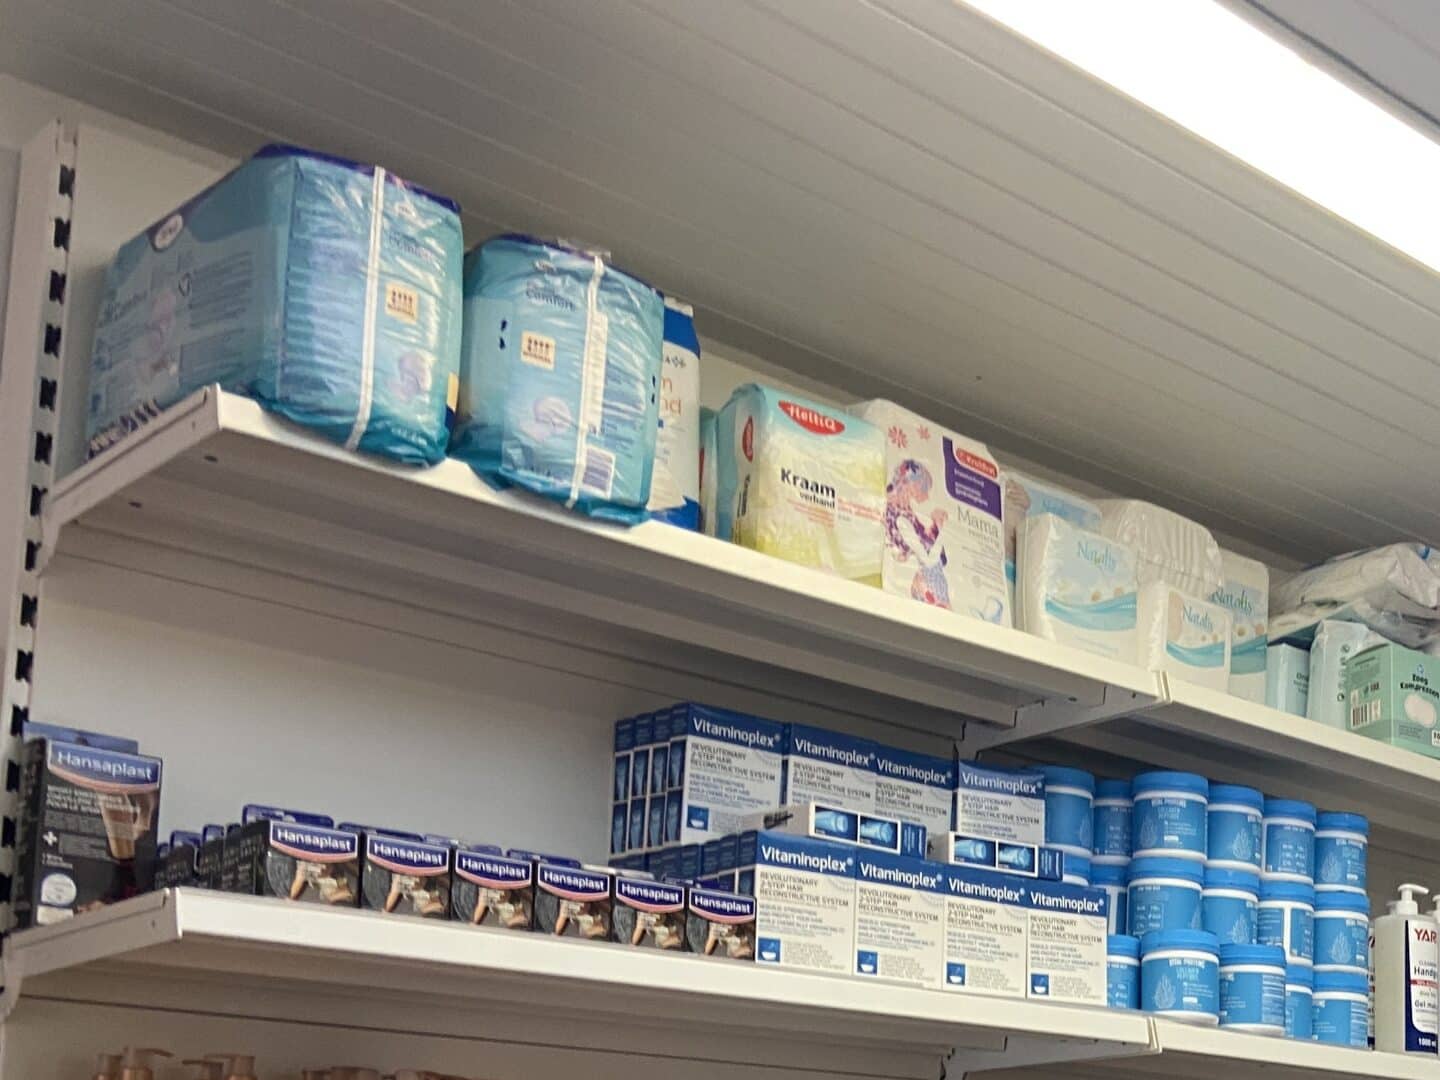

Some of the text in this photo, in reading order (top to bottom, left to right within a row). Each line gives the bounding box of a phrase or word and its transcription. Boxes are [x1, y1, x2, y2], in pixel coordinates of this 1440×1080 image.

[780, 467, 836, 499] Kraam
[957, 506, 999, 537] Mama
[57, 750, 153, 781] Hansaplast
[276, 828, 353, 853] Hansaplast
[373, 842, 444, 867] Hansaplast
[461, 856, 527, 881] Hansaplast
[543, 869, 605, 893] Hansaplast
[621, 882, 680, 905] Hansaplast
[694, 895, 752, 916] Hansaplast
